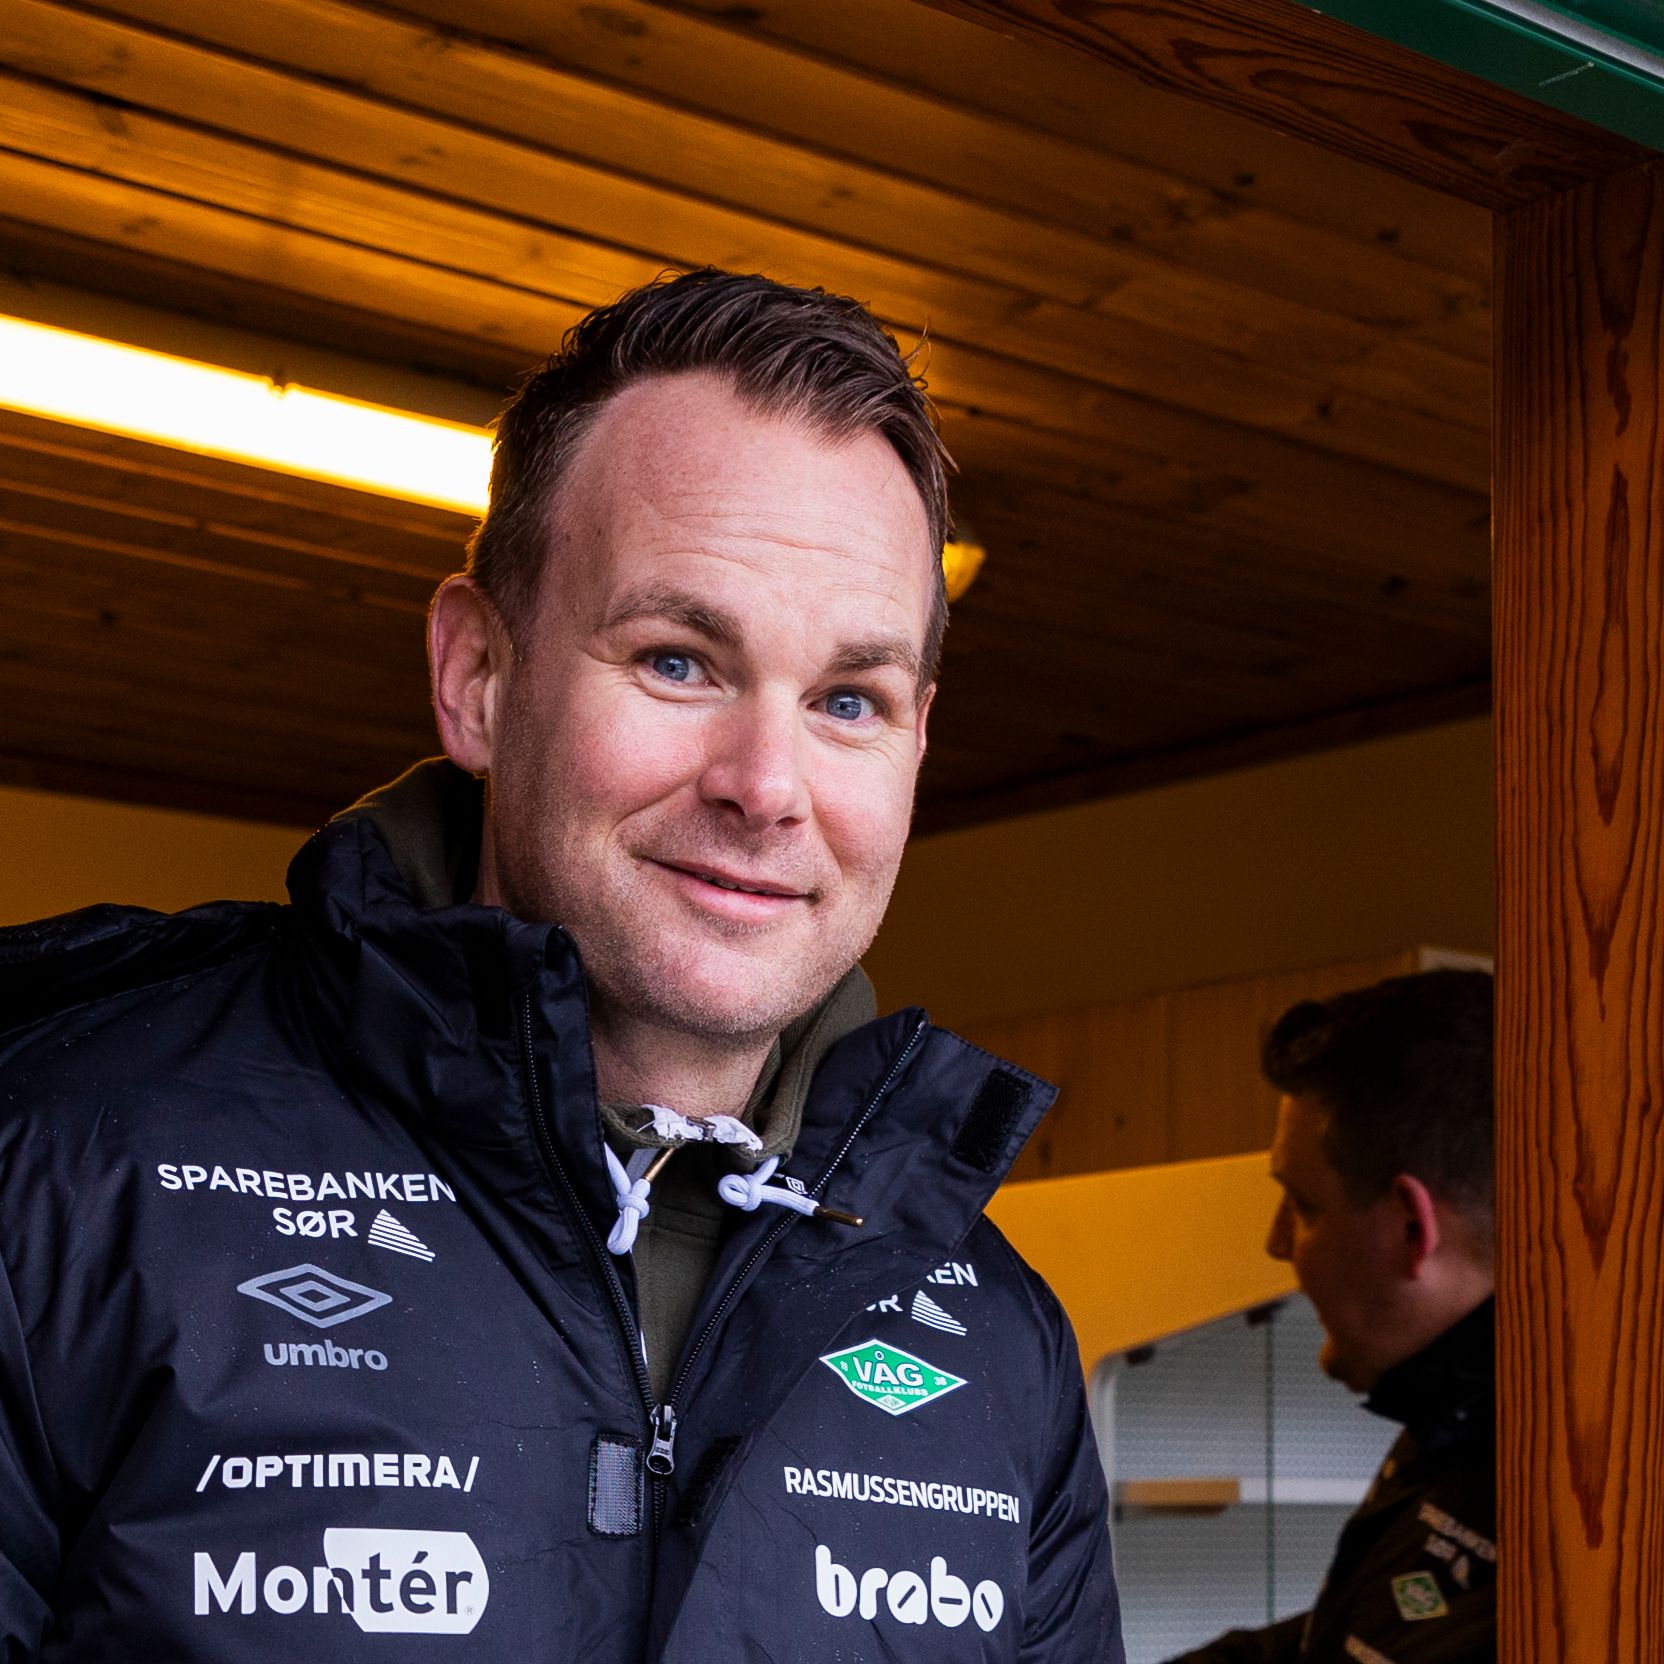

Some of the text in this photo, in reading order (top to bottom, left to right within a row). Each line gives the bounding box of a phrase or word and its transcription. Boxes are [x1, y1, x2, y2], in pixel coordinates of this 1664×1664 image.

[157, 1163, 457, 1203] SPAREBANKEN
[272, 1207, 358, 1239] SØR
[263, 1339, 388, 1371] umbro
[852, 1350, 924, 1387] VÅG
[783, 1466, 1020, 1524] RASMUSSENGRUPPEN
[193, 1550, 473, 1616] Montér
